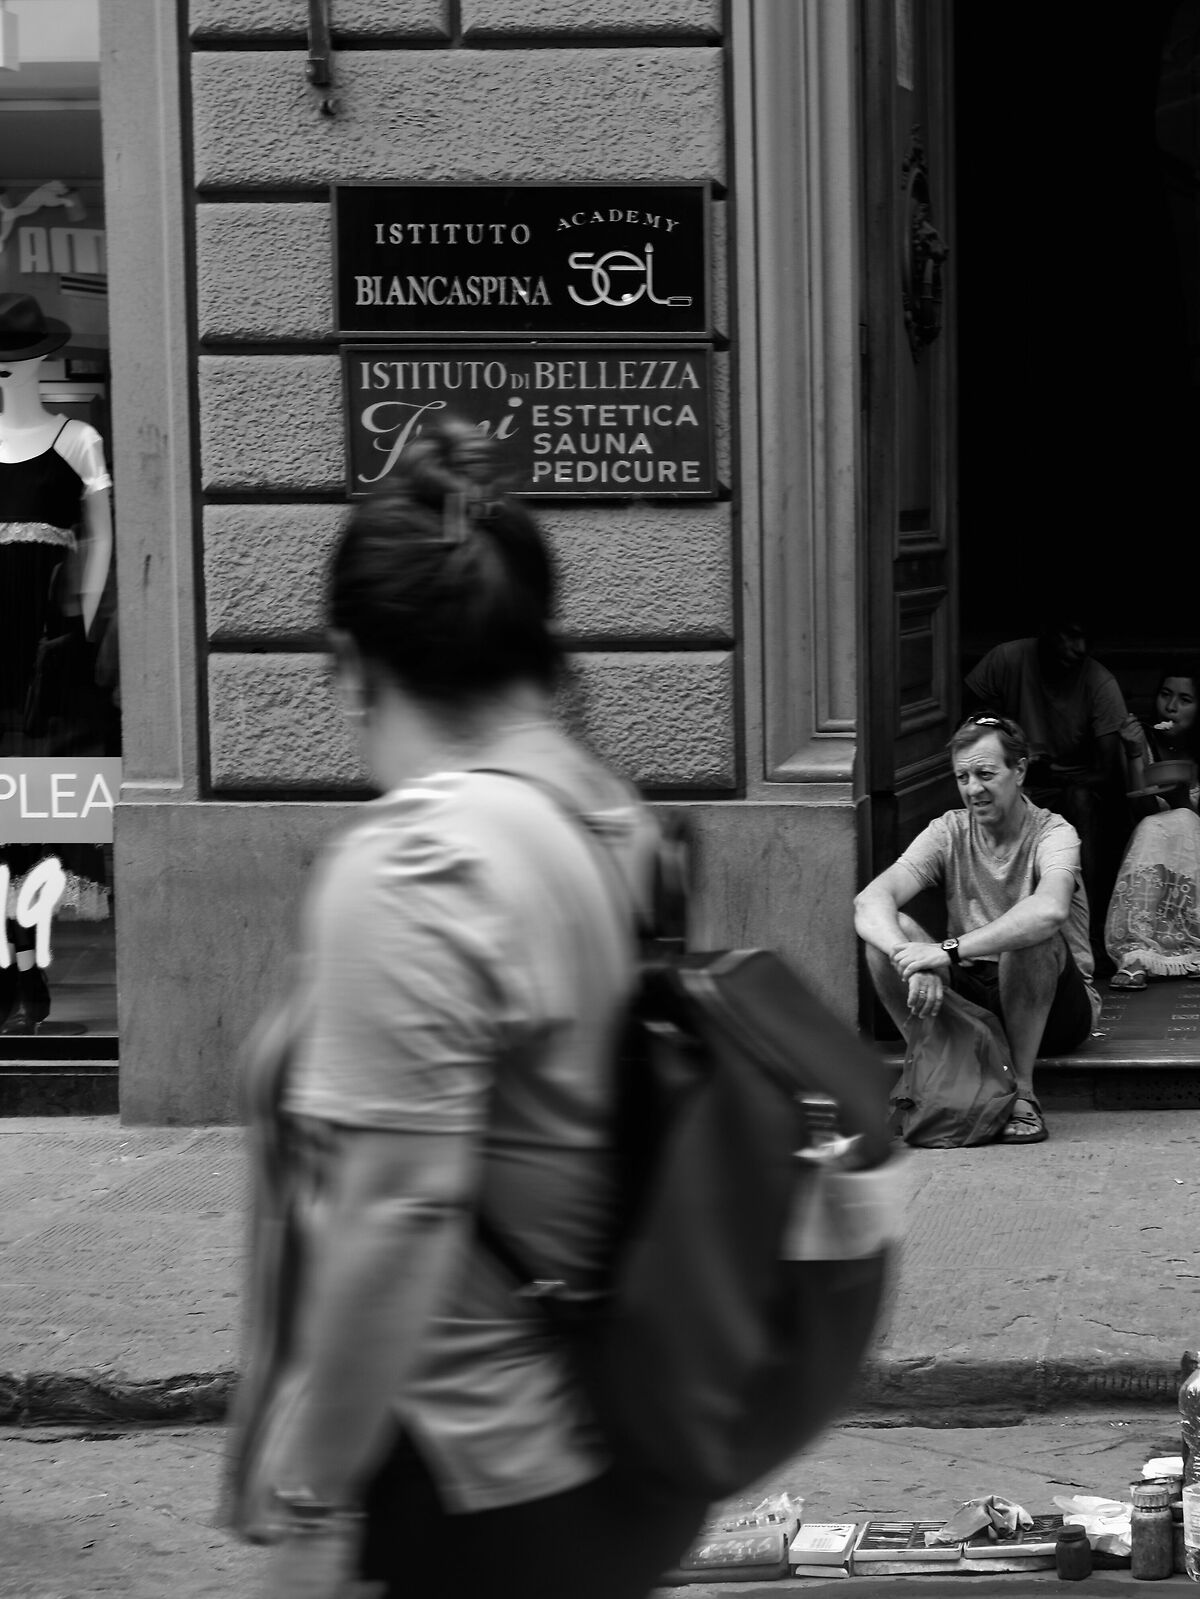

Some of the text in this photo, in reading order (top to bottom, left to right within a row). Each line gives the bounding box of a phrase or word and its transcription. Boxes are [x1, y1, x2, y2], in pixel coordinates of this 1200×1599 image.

[556, 208, 681, 233] ACADEMY
[375, 222, 531, 245] ISTITUTO
[354, 275, 552, 306] BIANCASPINA
[360, 361, 701, 390] ISTITUTO DI BELLEZZA
[532, 404, 699, 427] ESTETICA
[533, 432, 654, 455] SAUNA
[533, 460, 701, 483] PEDICURE
